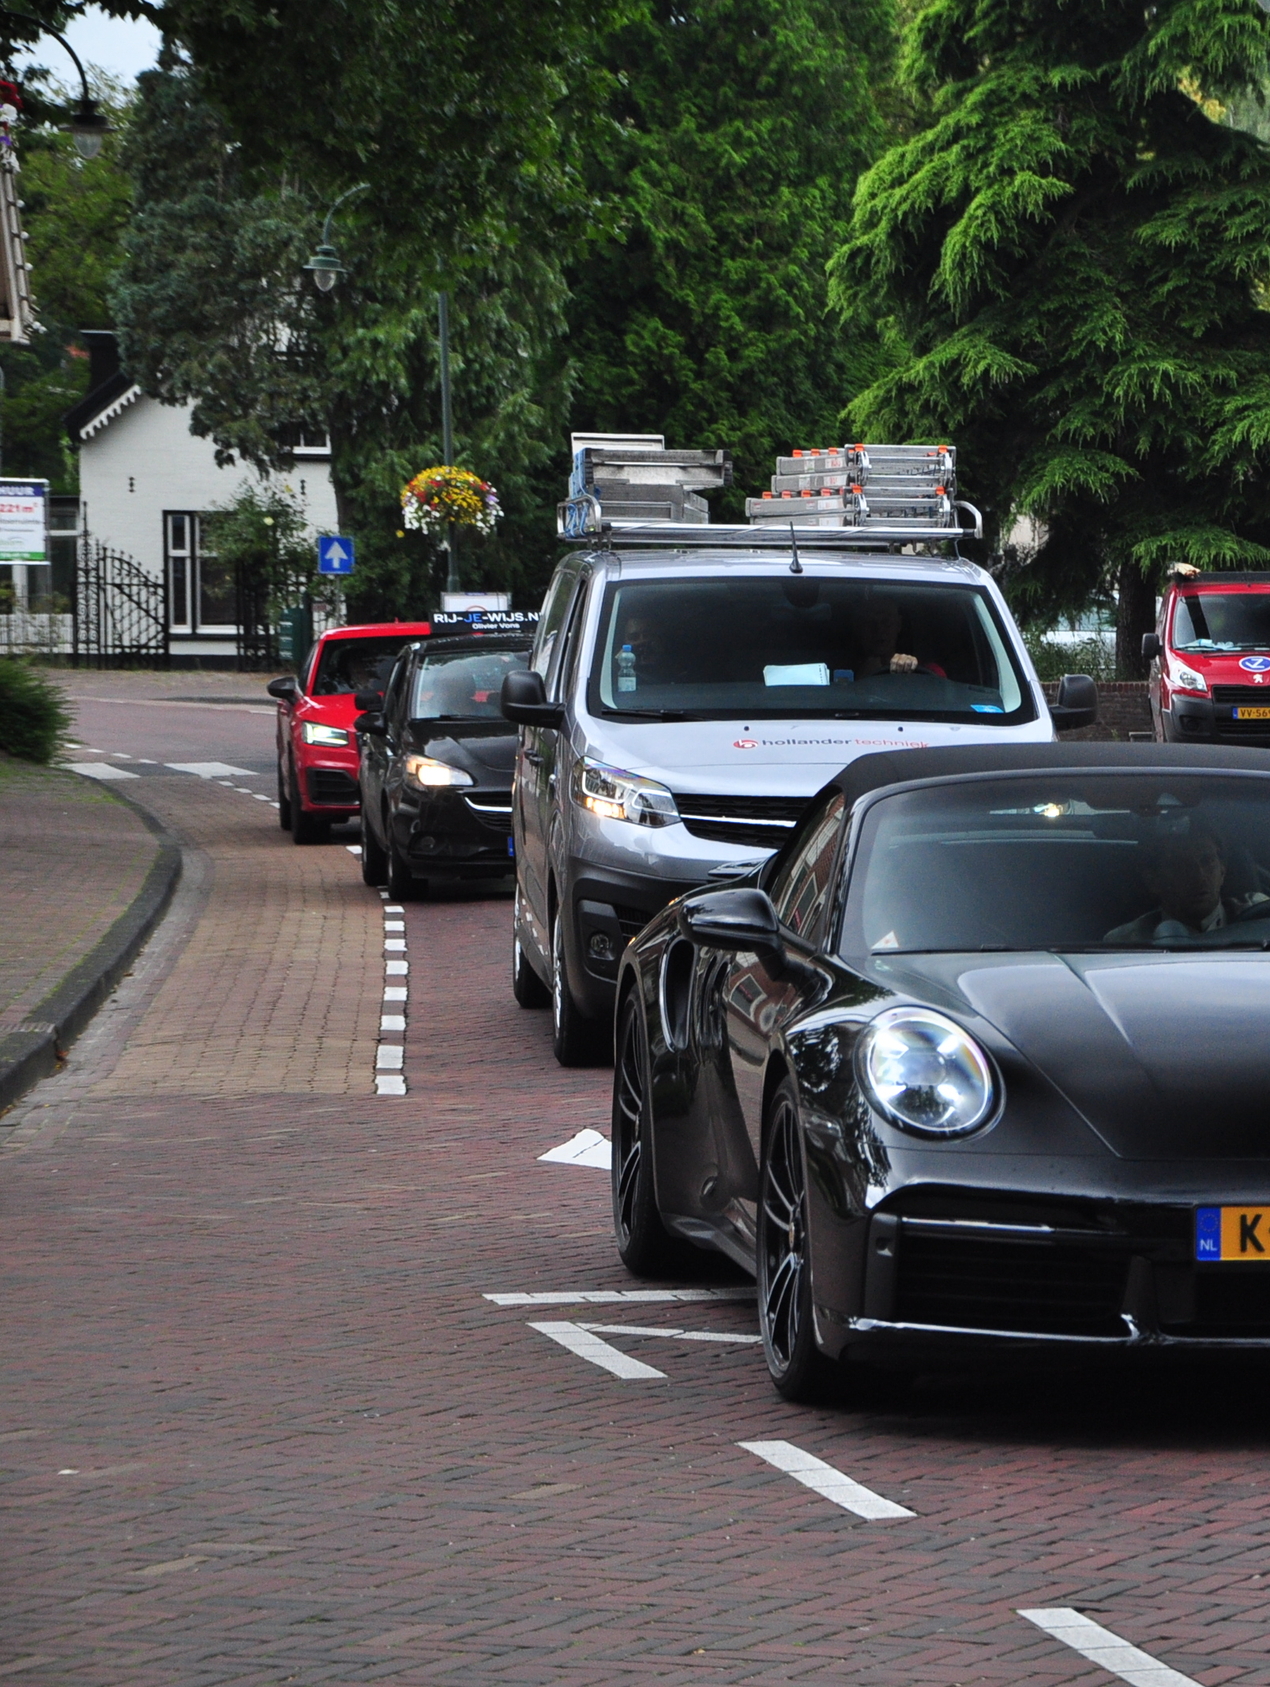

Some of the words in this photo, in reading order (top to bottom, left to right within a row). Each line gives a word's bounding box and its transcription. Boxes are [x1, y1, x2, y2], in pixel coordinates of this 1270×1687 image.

[433, 611, 542, 623] RIJ-JE-WIJS.N
[762, 738, 852, 746] hollander
[855, 738, 929, 749] techniek
[1200, 1239, 1217, 1251] NL
